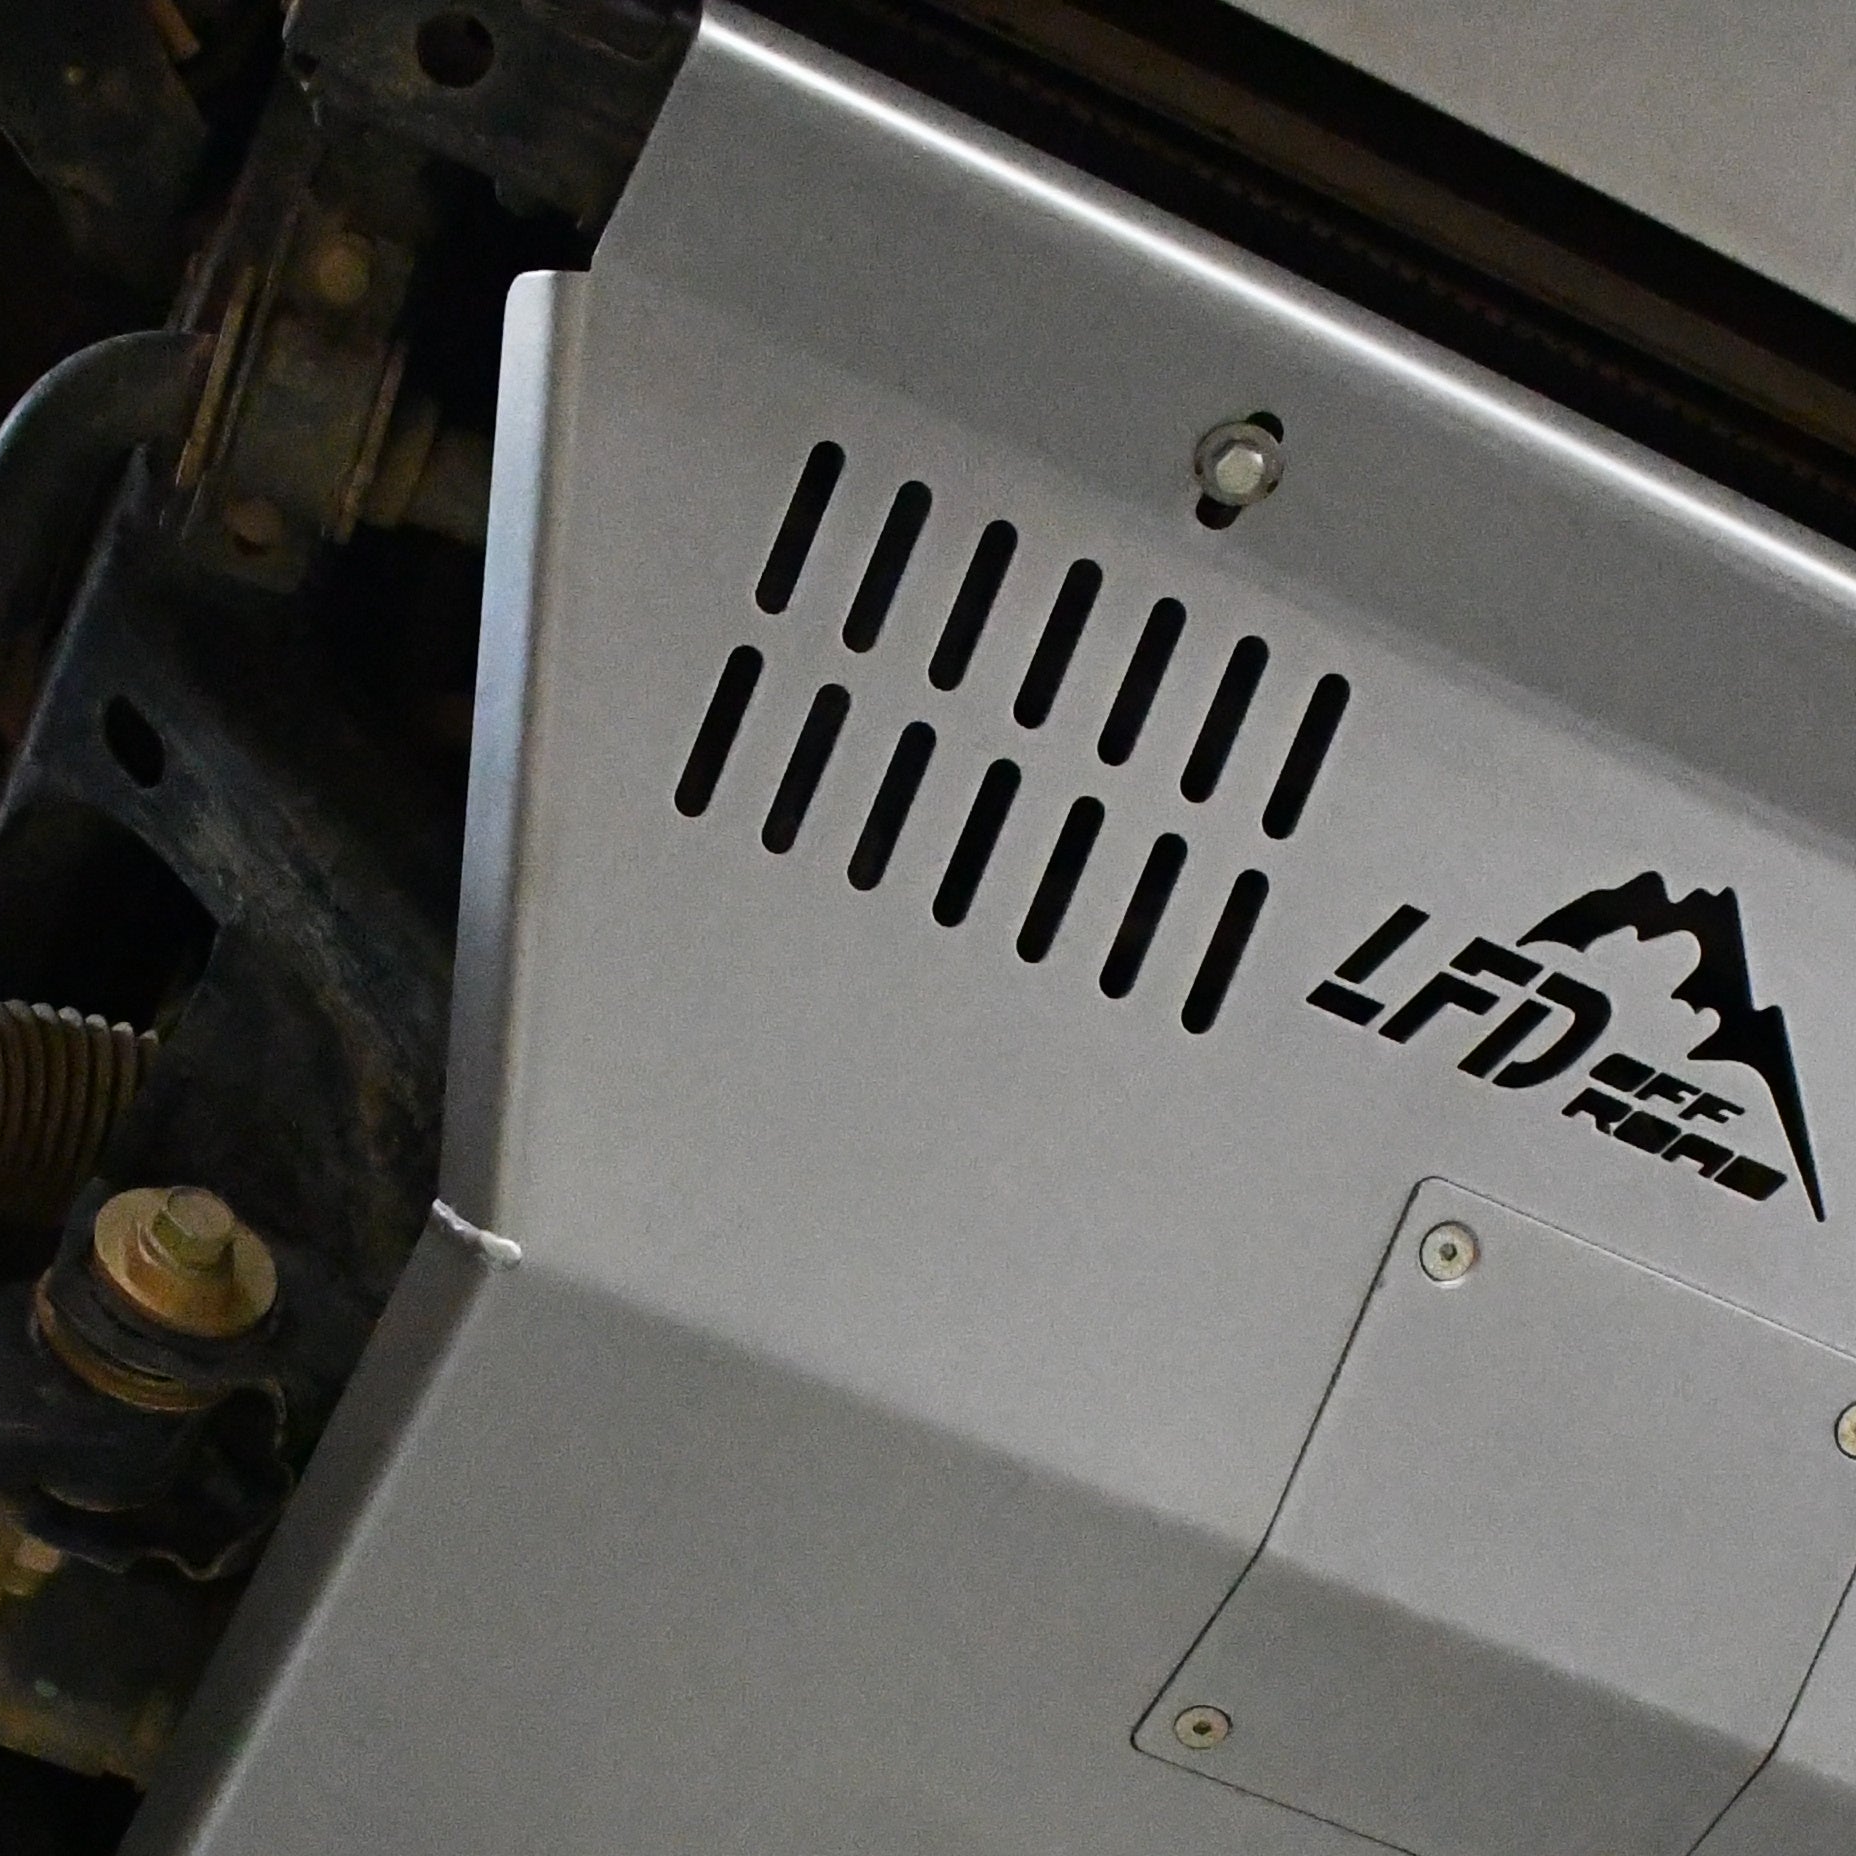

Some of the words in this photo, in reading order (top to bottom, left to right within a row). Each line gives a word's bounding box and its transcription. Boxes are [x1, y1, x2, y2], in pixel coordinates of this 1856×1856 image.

[1305, 903, 1612, 1088] LFD
[1561, 1086, 1788, 1201] ROAD
[1589, 1052, 1745, 1124] OFF
